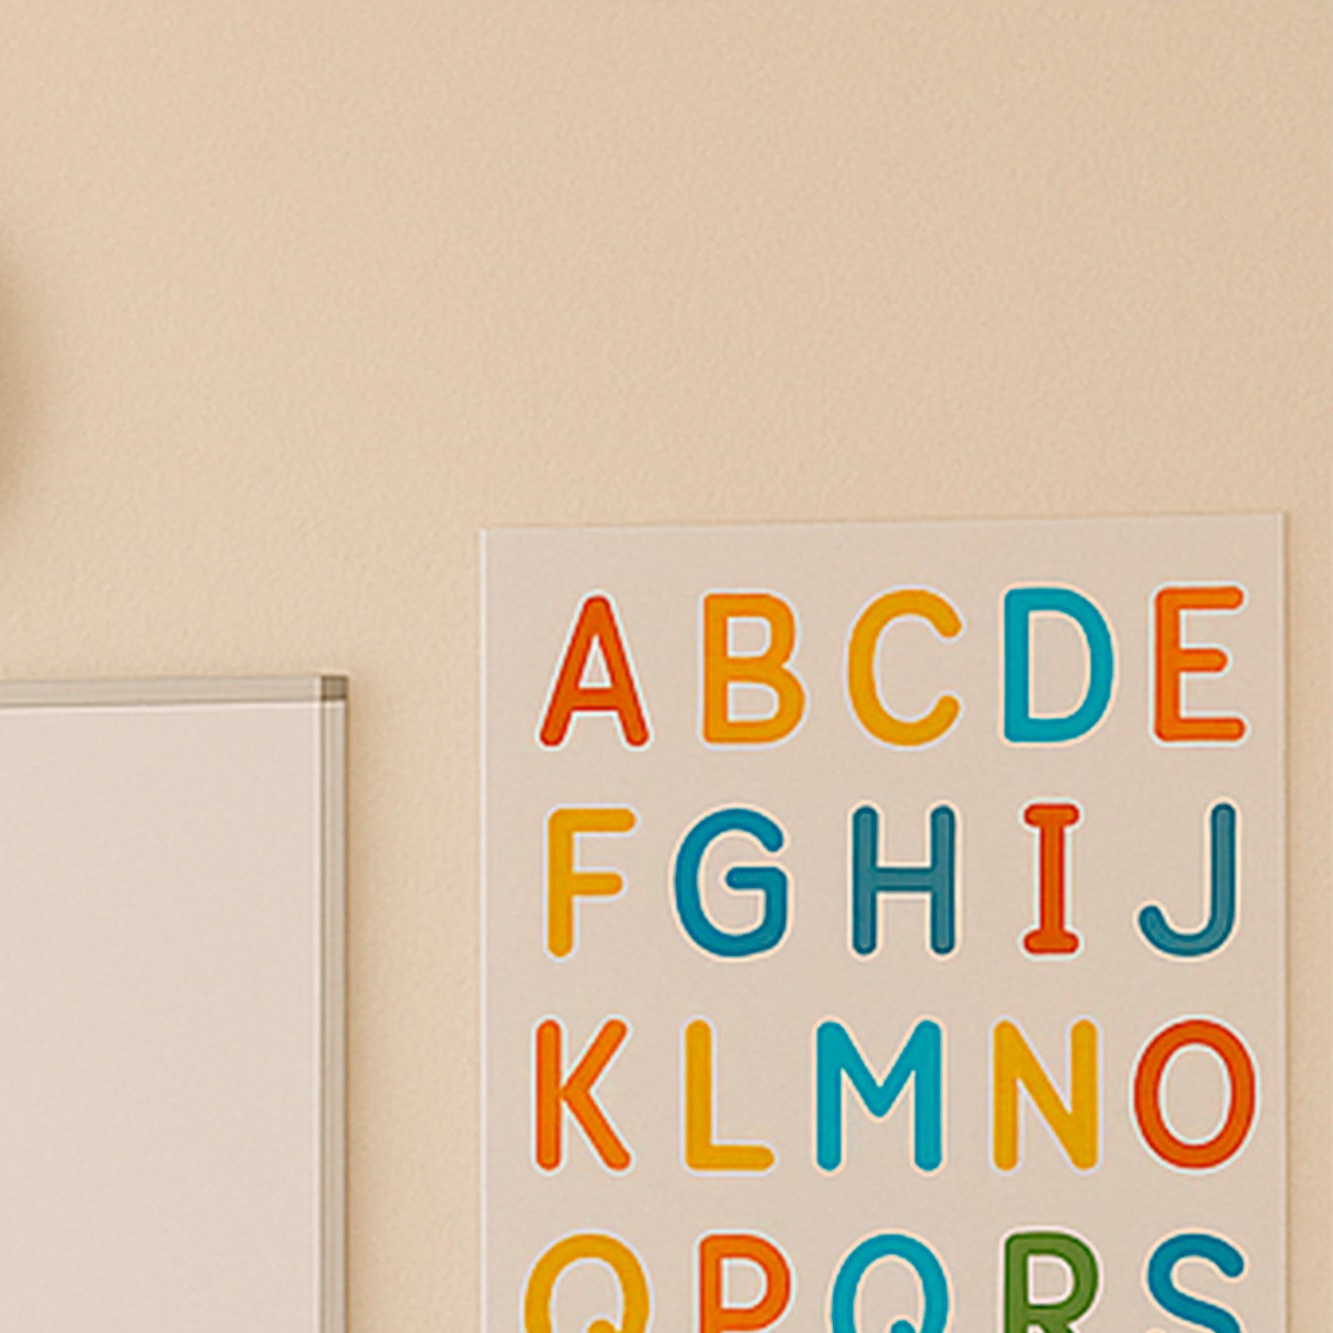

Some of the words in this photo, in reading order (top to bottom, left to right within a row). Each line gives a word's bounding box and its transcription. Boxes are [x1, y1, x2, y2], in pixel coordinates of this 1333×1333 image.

[540, 596, 649, 746] A
[703, 594, 805, 744] B
[848, 589, 962, 746] C
[1005, 588, 1113, 742] D
[1154, 586, 1246, 742] E
[548, 808, 636, 957] F
[675, 809, 787, 956] G
[853, 806, 954, 954] H
[1024, 804, 1080, 955] I
[1139, 804, 1235, 956] J
[536, 1019, 631, 1171] K
[685, 1020, 775, 1171] L
[817, 1020, 941, 1171] M
[993, 1020, 1098, 1171] N
[1134, 1020, 1255, 1169] O
